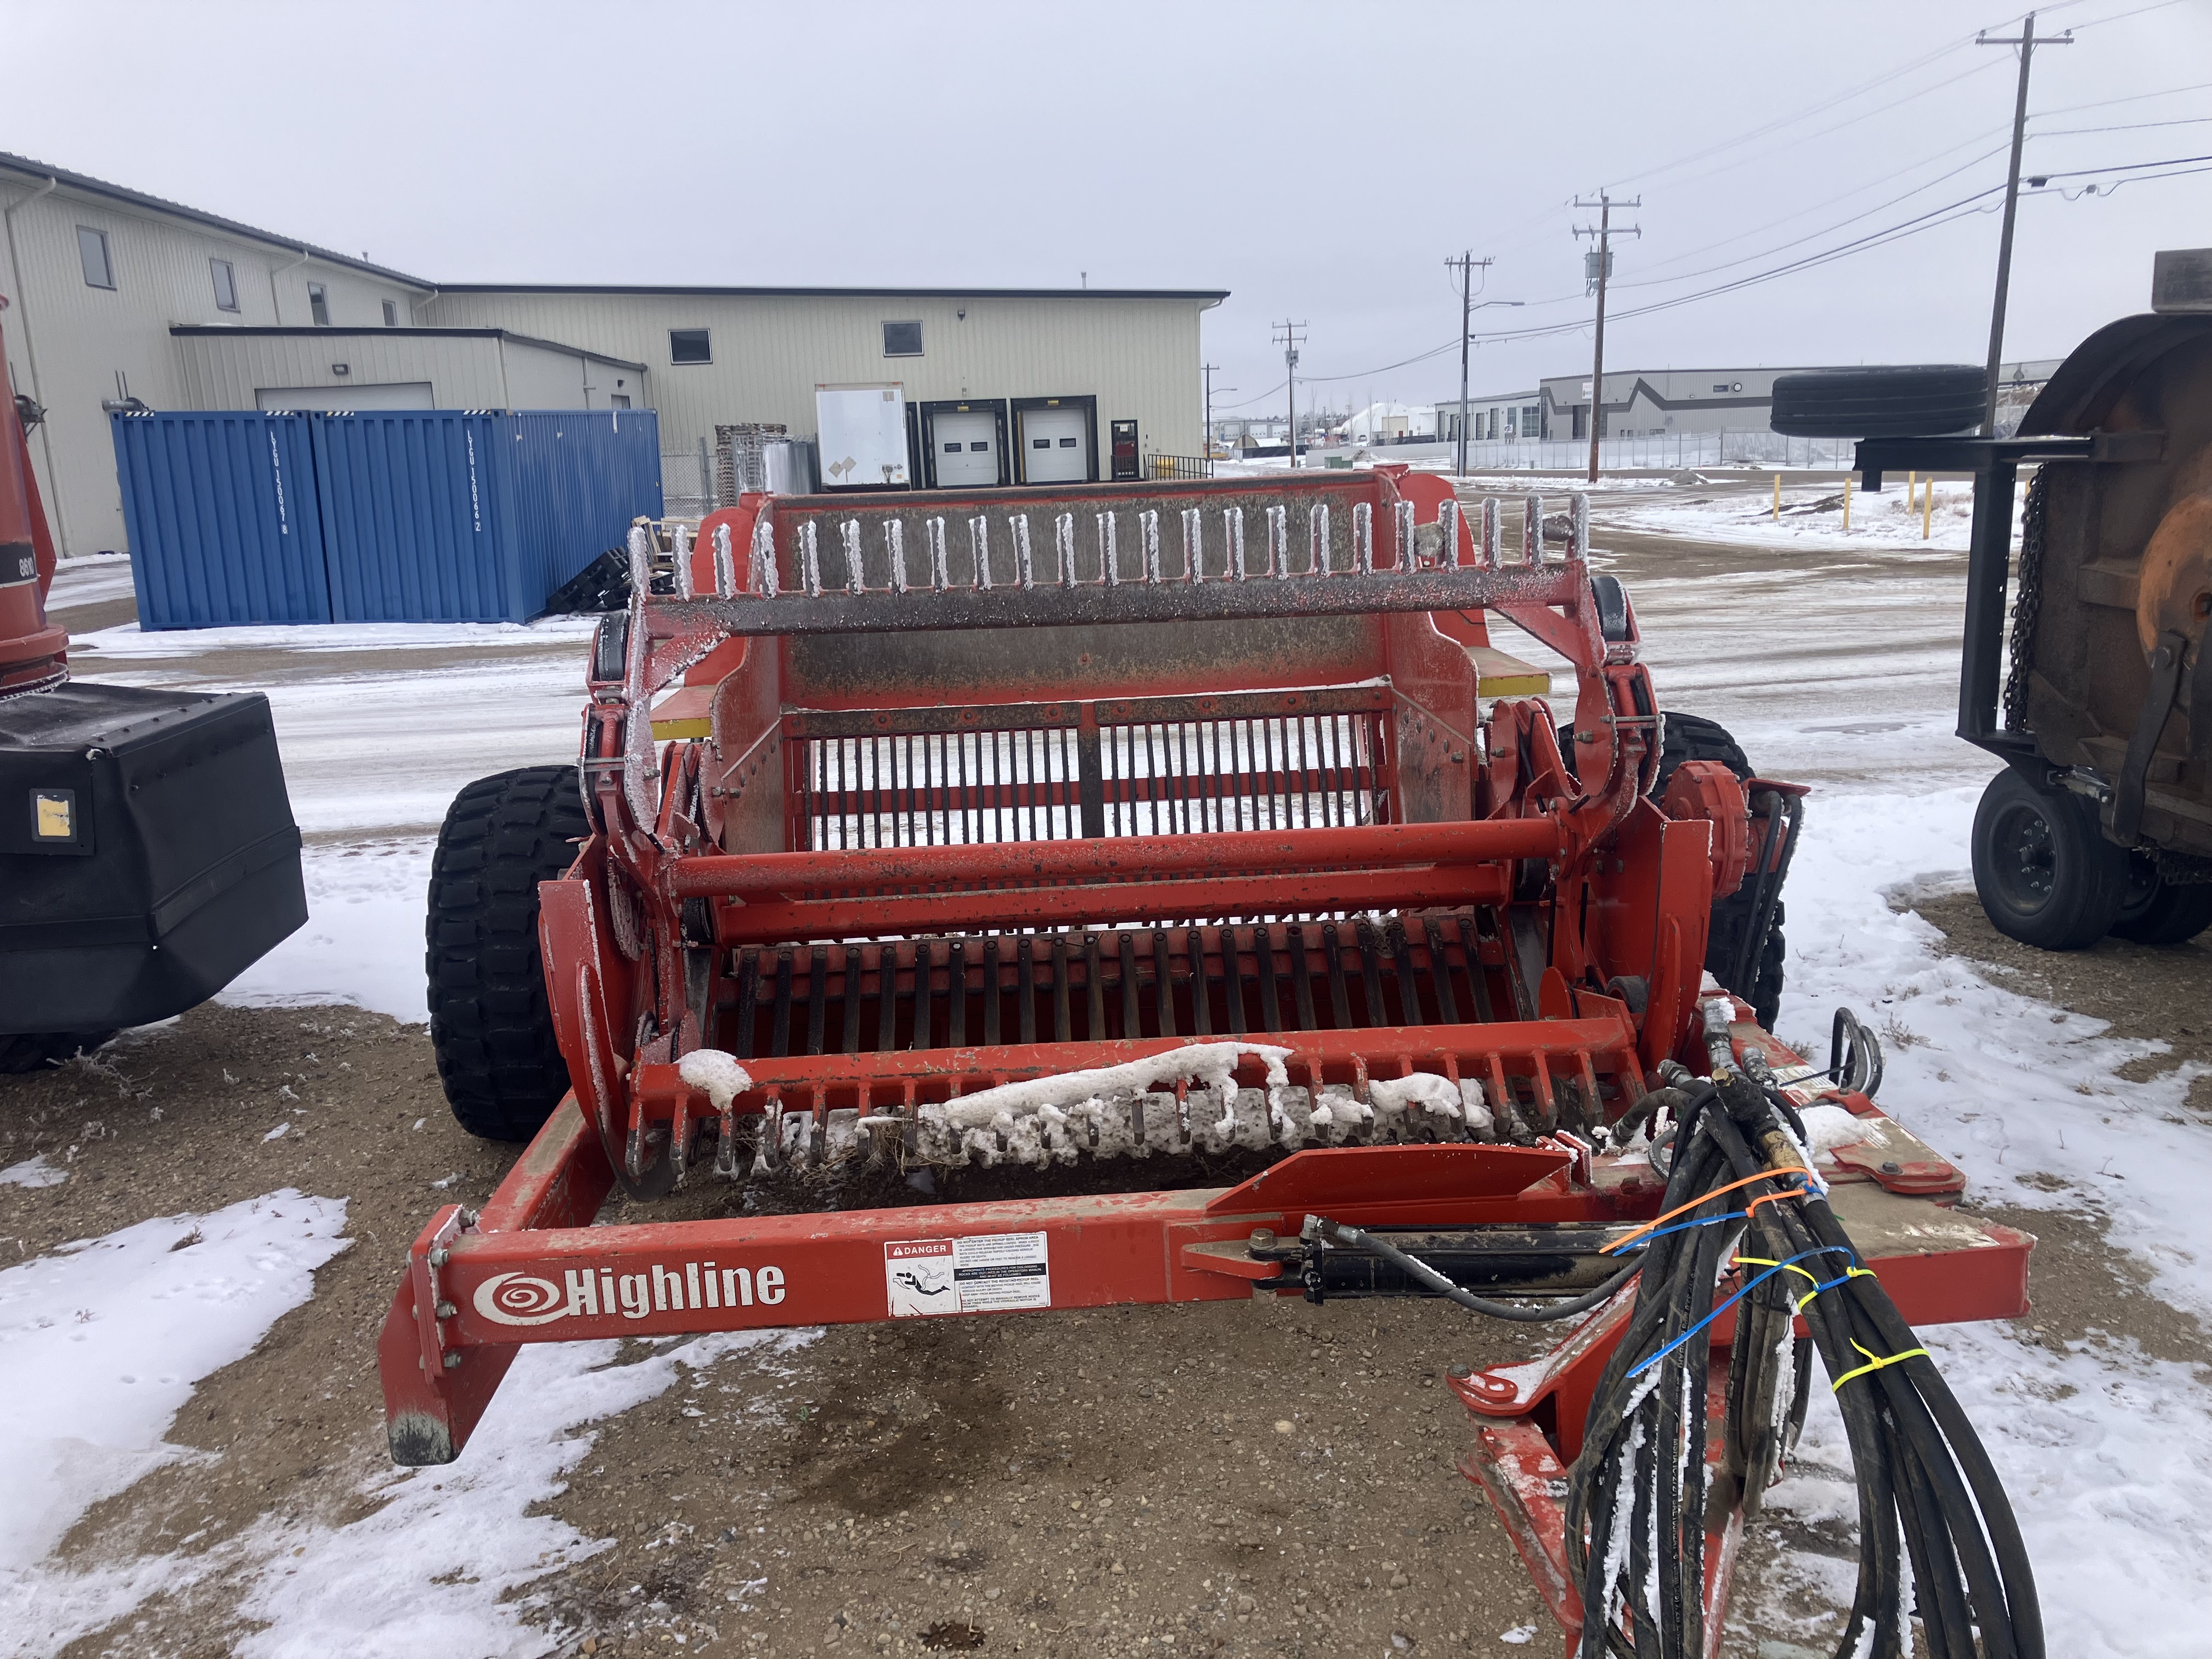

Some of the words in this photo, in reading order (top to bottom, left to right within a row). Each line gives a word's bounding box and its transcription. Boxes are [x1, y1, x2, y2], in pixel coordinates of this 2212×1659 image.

[270, 430, 279, 466] LYGU
[276, 469, 285, 521] 150067
[282, 524, 287, 534] 8
[471, 467, 479, 519] 150066
[476, 522, 481, 531] 2
[904, 1245, 947, 1255] DANGER
[563, 1262, 786, 1319] Highline
